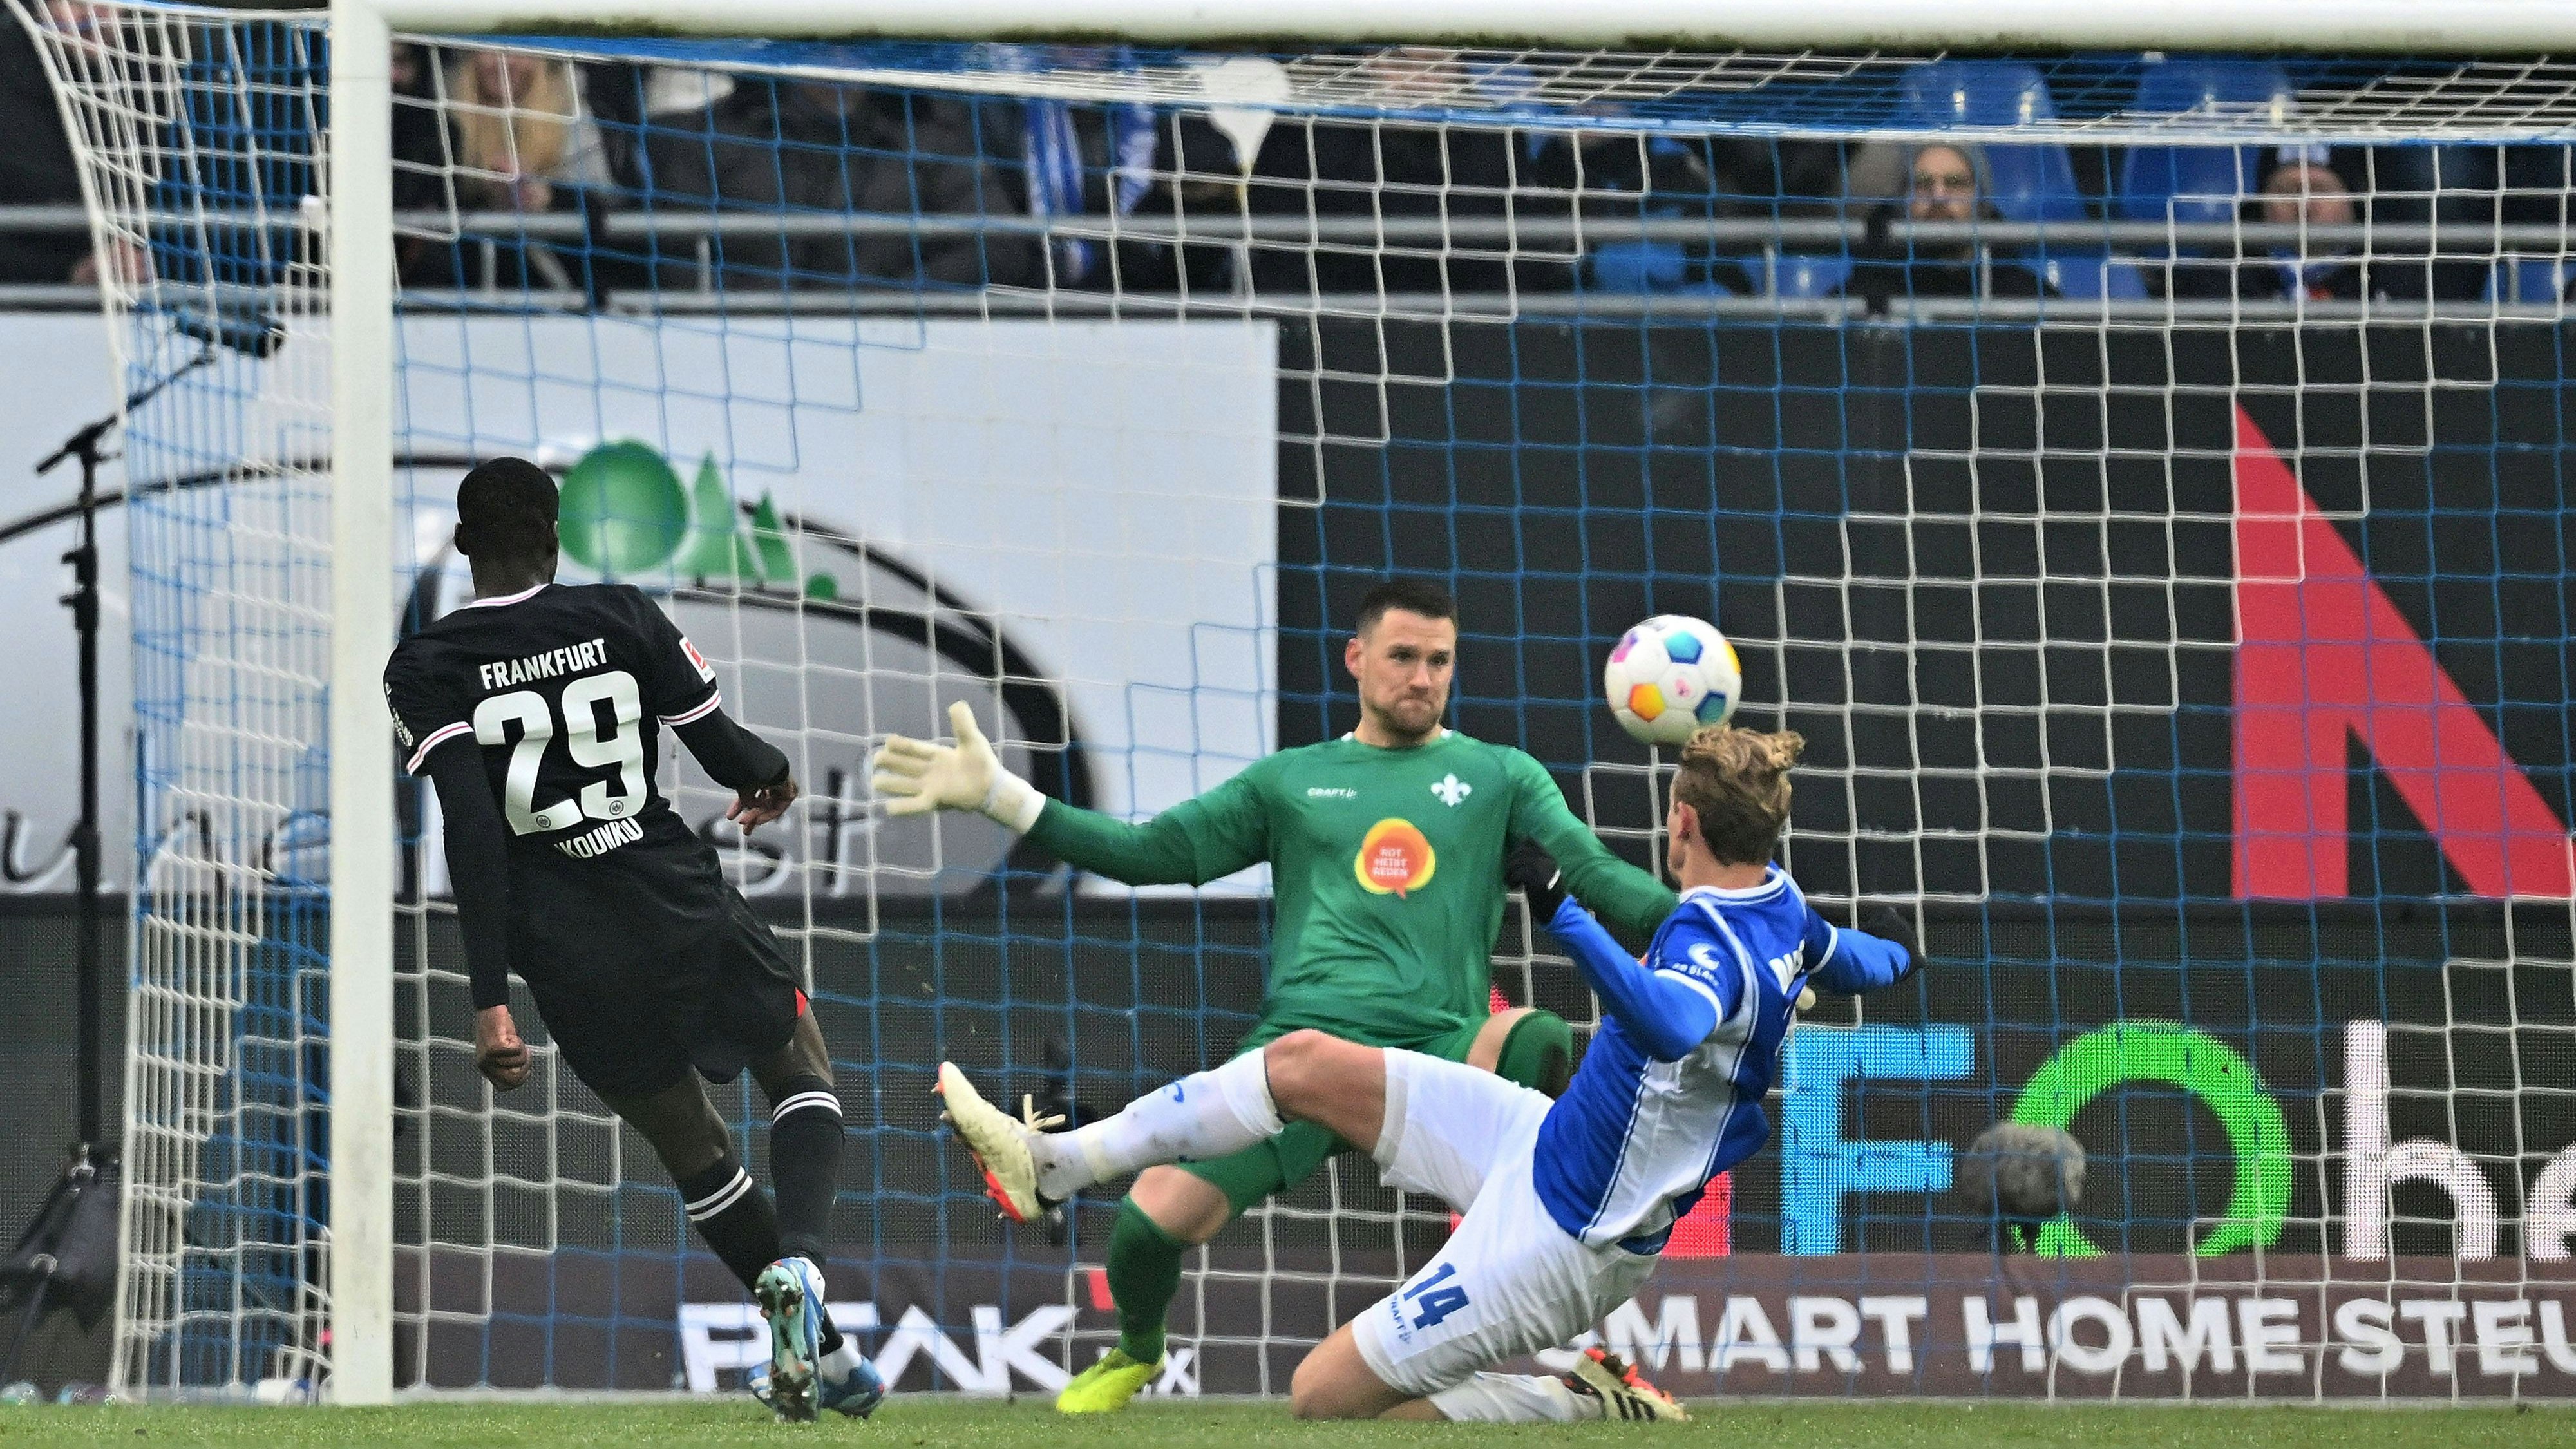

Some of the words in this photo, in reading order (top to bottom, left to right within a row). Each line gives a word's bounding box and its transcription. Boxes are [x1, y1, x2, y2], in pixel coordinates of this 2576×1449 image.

[479, 638, 605, 690] FRANKFURT
[474, 670, 647, 836] 29
[554, 817, 644, 858] KOUNKU
[1403, 1262, 1470, 1330] 14
[1962, 1296, 2306, 1374] HOME
